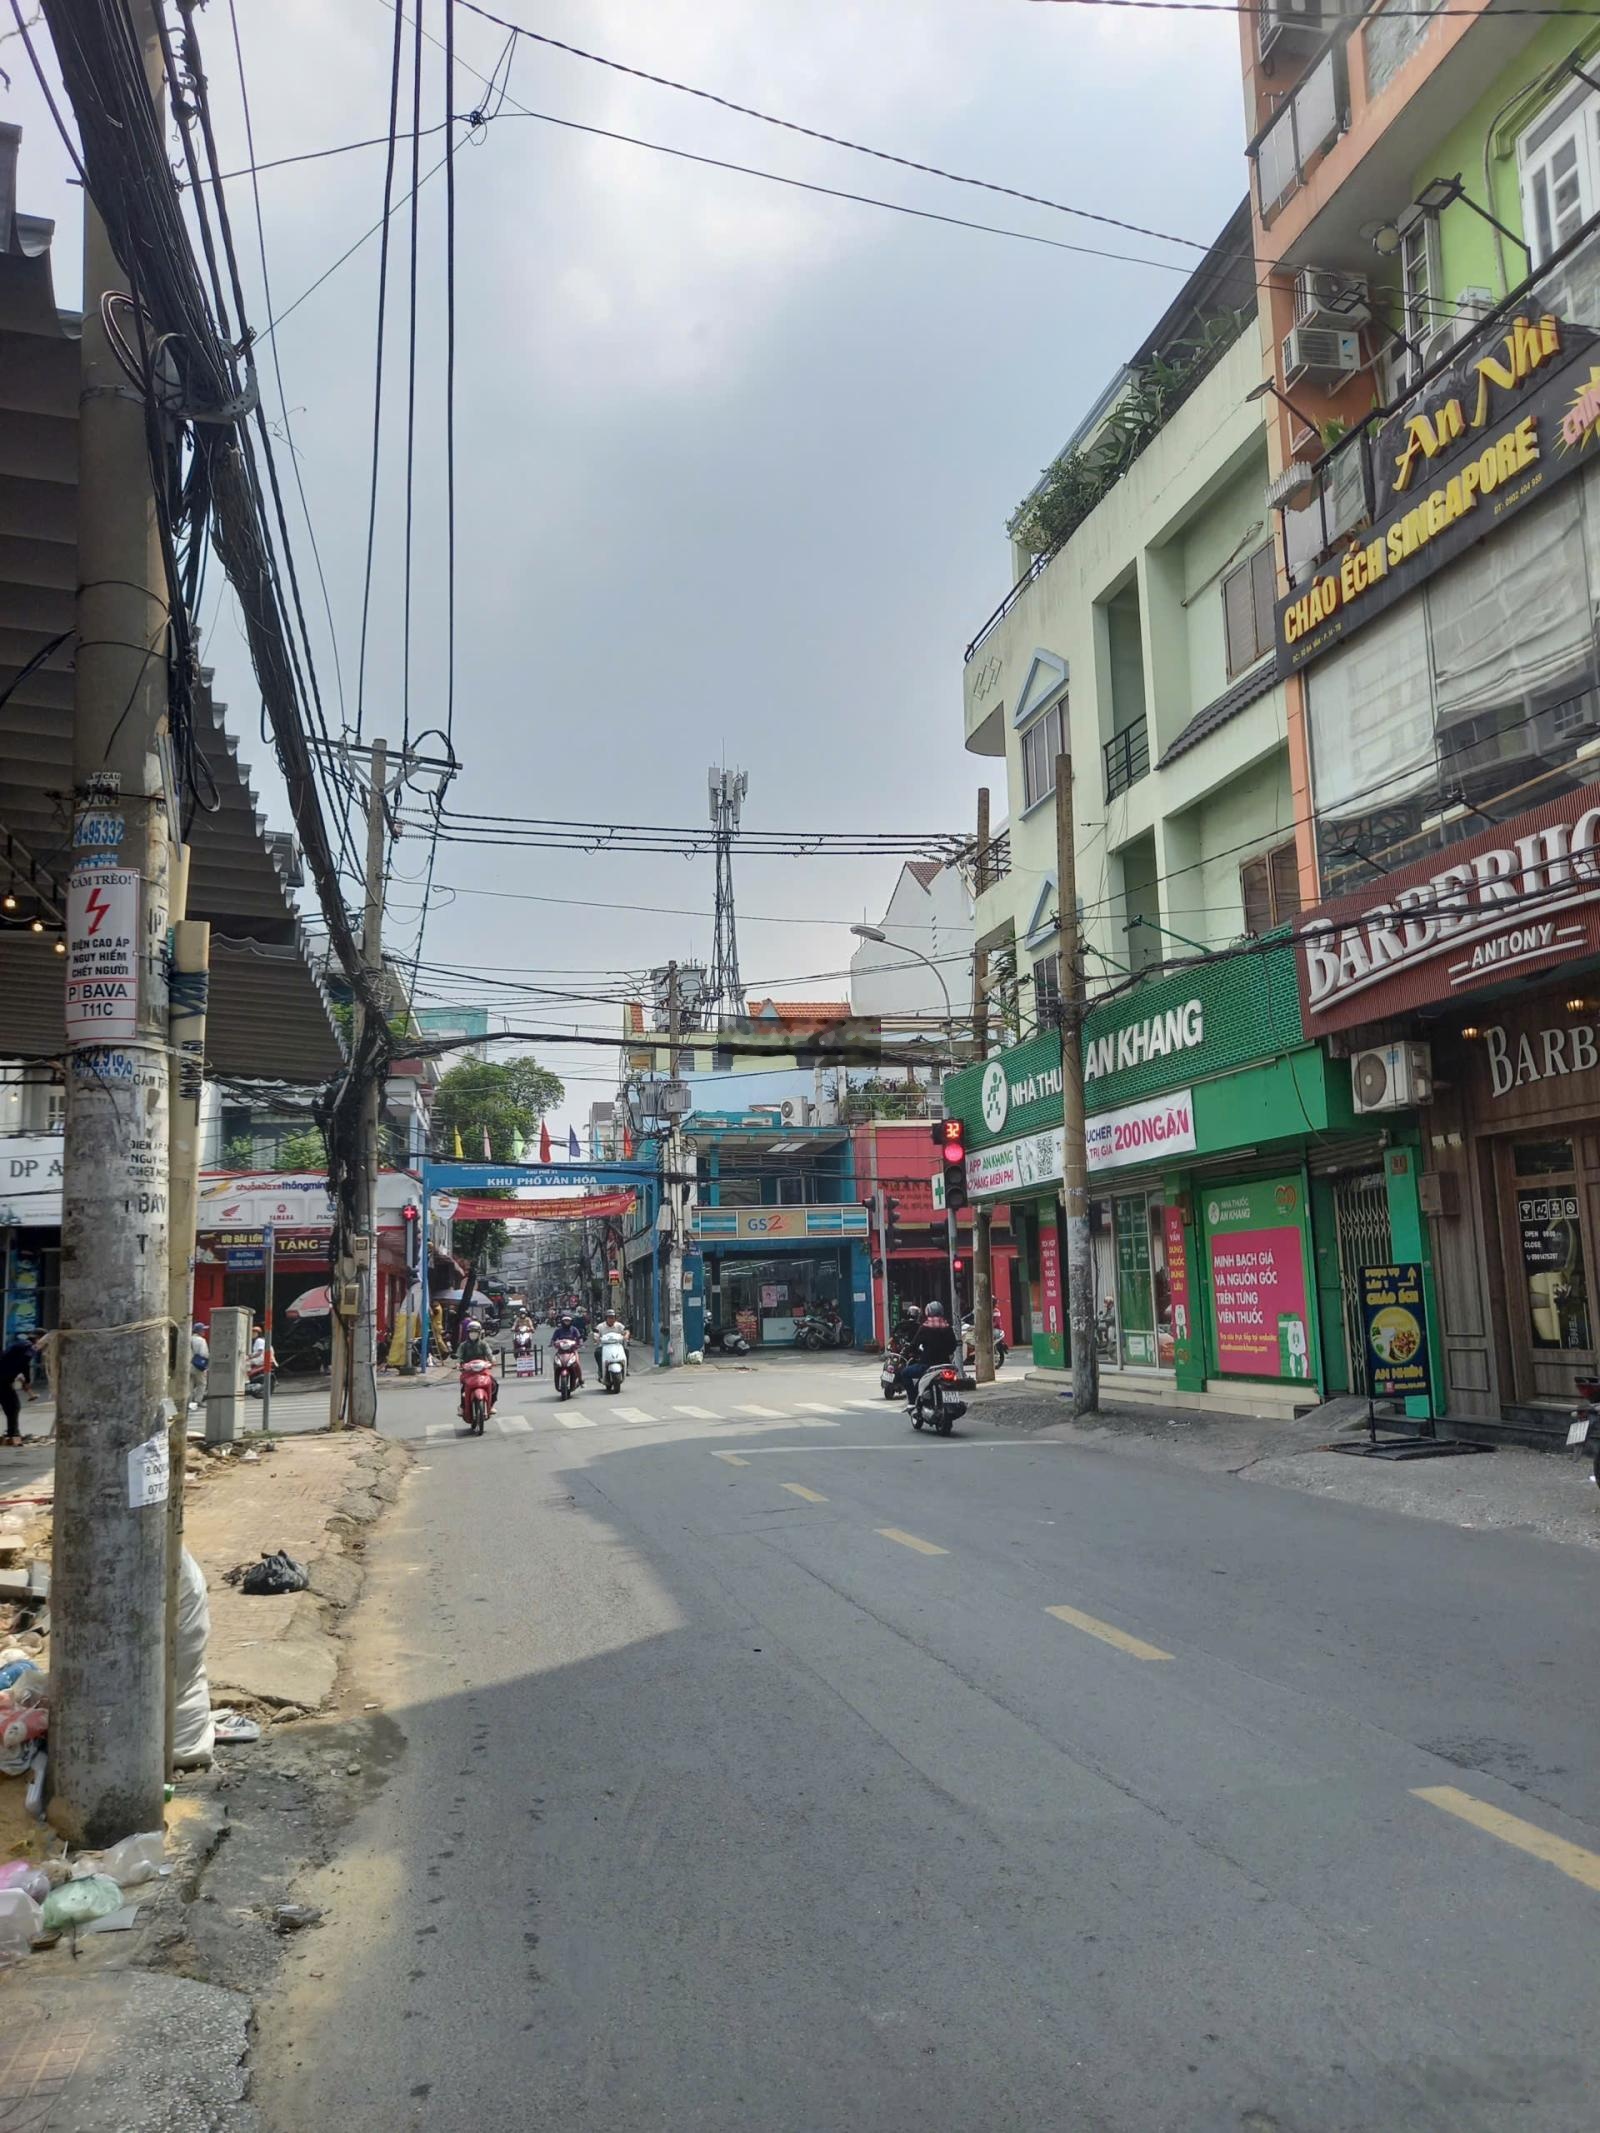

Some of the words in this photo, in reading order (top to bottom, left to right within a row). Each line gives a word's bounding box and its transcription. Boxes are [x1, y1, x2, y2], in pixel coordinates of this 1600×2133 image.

[1392, 398, 1466, 492] An
[1470, 314, 1561, 427] Nhi
[1284, 575, 1337, 644] CHÁO
[1341, 540, 1388, 604] ẾCH
[1387, 414, 1540, 567] SINGAPORE
[92, 938, 112, 948] CAO
[116, 936, 130, 947] ÁP
[1472, 922, 1556, 968] ANTONY
[73, 953, 95, 964] NGUY
[72, 964, 92, 978] CHẾT
[69, 986, 76, 1000] P
[83, 983, 128, 998] BAVA
[81, 1002, 113, 1016] T11C
[1011, 1073, 1036, 1107] NHÀ
[1037, 1066, 1063, 1099] THU
[1084, 1032, 1114, 1082] AN
[1118, 999, 1204, 1070] KHANG
[946, 1122, 960, 1138] 32
[1086, 1124, 1112, 1143] UCHER
[1115, 1120, 1143, 1151] 200
[10, 1160, 39, 1177] DP
[969, 1157, 981, 1174] APP
[487, 1177, 513, 1186] KHU
[517, 1174, 543, 1185] PHỐ
[544, 1176, 569, 1185] VĂN
[573, 1175, 598, 1185] HÓA
[138, 1192, 167, 1214] BAV
[747, 1214, 790, 1232] GS2
[1220, 1210, 1230, 1222] AN
[1230, 1208, 1250, 1221] KHANG
[278, 1238, 319, 1252] TẶNG
[1214, 1255, 1234, 1268] MINH
[1236, 1252, 1257, 1270] BẠCH
[1259, 1249, 1273, 1265] GIÁ
[1215, 1271, 1225, 1286] VÀ
[1259, 1266, 1277, 1284] GỐC
[1216, 1290, 1235, 1305] TRÊN
[1218, 1310, 1236, 1323] VIÊN
[1236, 1306, 1263, 1324] THUỐC
